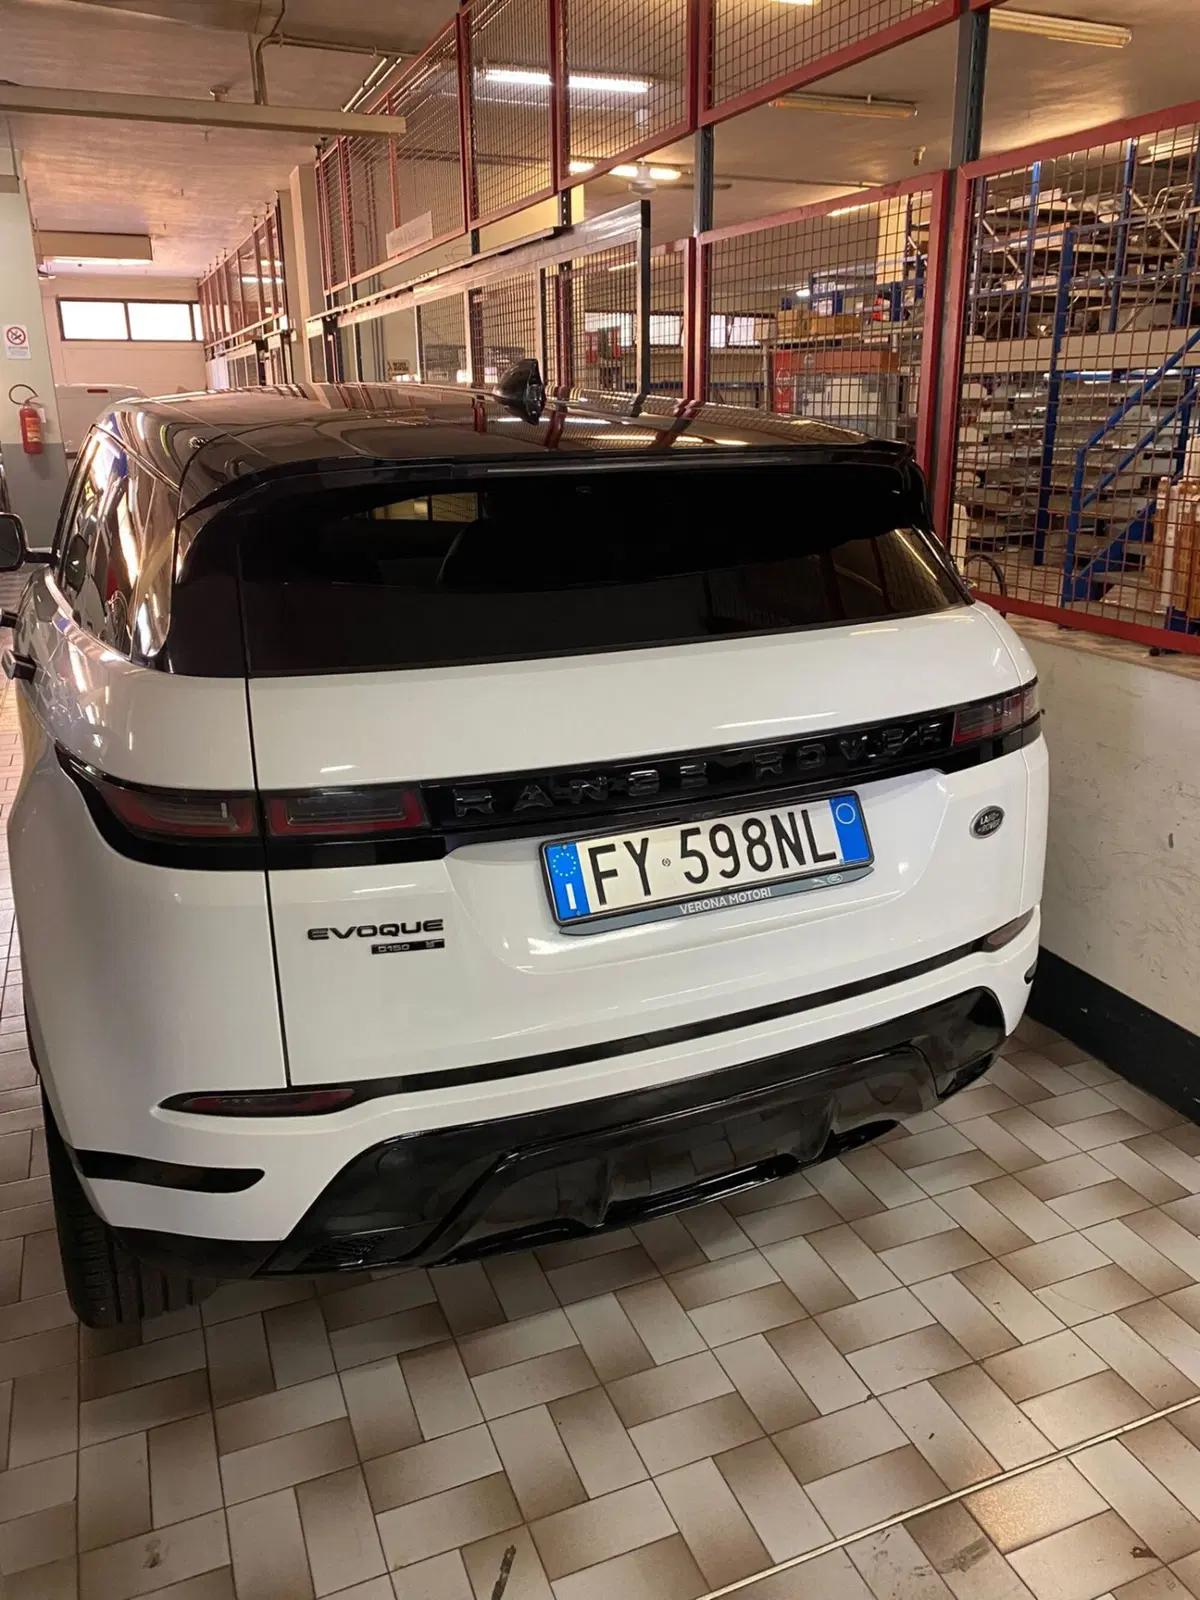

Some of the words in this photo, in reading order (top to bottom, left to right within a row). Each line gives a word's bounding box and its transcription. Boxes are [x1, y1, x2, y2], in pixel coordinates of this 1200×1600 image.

[452, 762, 708, 818] RANGE
[753, 722, 943, 780] ROVER
[588, 837, 650, 906] FY
[679, 809, 838, 885] 598NL
[307, 918, 444, 941] EVOQUE
[679, 894, 728, 915] VERONA
[728, 887, 772, 906] MOTORI
